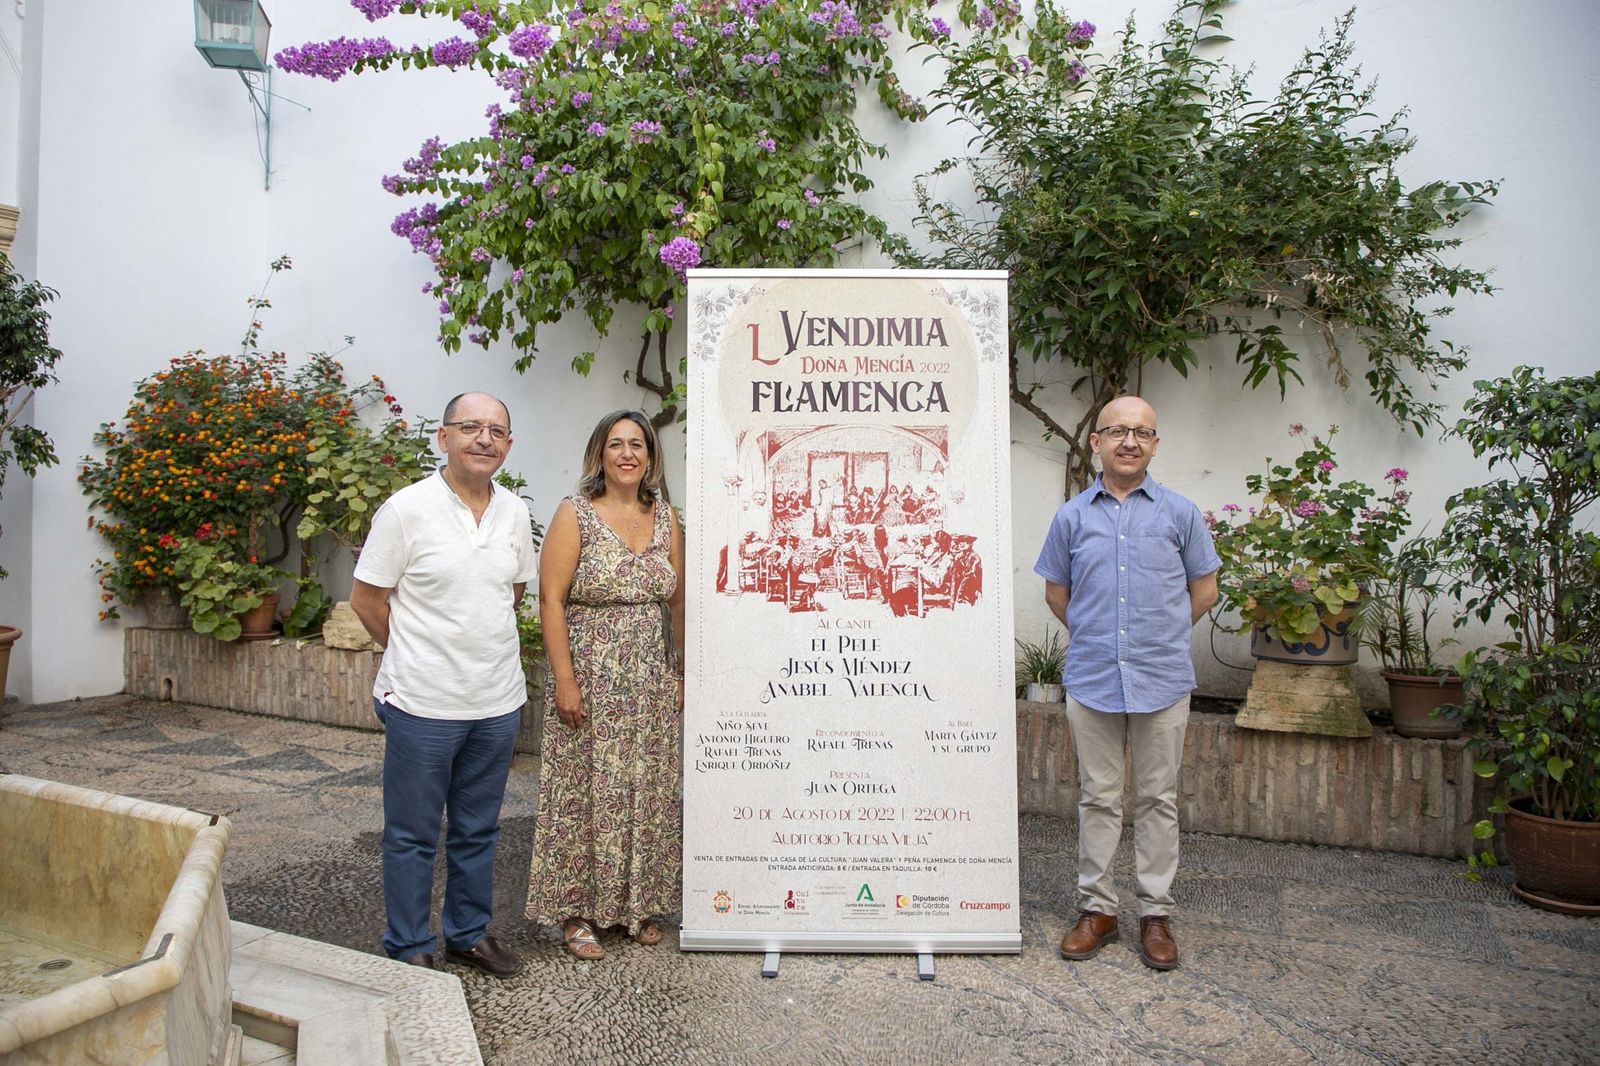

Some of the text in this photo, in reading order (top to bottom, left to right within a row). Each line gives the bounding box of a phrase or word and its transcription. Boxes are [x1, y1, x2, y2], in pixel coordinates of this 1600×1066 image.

[746, 310, 949, 366] L VENDIMIA
[800, 354, 950, 376] DOÑA MENCÍA 2022
[750, 380, 950, 413] FLAMENCA
[817, 617, 873, 630] AL CANTE
[811, 635, 881, 654] EL PELE
[780, 656, 912, 679] JESÚS MÉNDEZ
[759, 677, 940, 704] ANABEL VALENCIA
[716, 720, 771, 733] NIÑO SEVE
[695, 733, 790, 748] ANTONIO HIGUERO
[960, 729, 997, 741] GÁLVEZ
[807, 738, 894, 752] RAFAEL TRENAS
[931, 745, 991, 753] Y SU GRUPO
[704, 746, 782, 759] RAFAEL TRENAS
[695, 759, 791, 773] ENRIQUE ORDÓÑEZ
[830, 770, 870, 779] PRESENTA
[804, 780, 896, 796] JUAN ORTEGA
[732, 806, 753, 821] 20
[759, 808, 774, 821] DE
[781, 806, 837, 821] AGOSTO
[838, 808, 852, 821] DE
[858, 806, 895, 821] 2022
[914, 807, 957, 821] 22:00
[771, 832, 840, 846] AUDITORIO
[988, 856, 1012, 864] MENCÍA
[912, 894, 950, 902] Diputación
[922, 901, 950, 909] Córdoba
[959, 900, 1011, 912] Cruzcampo
